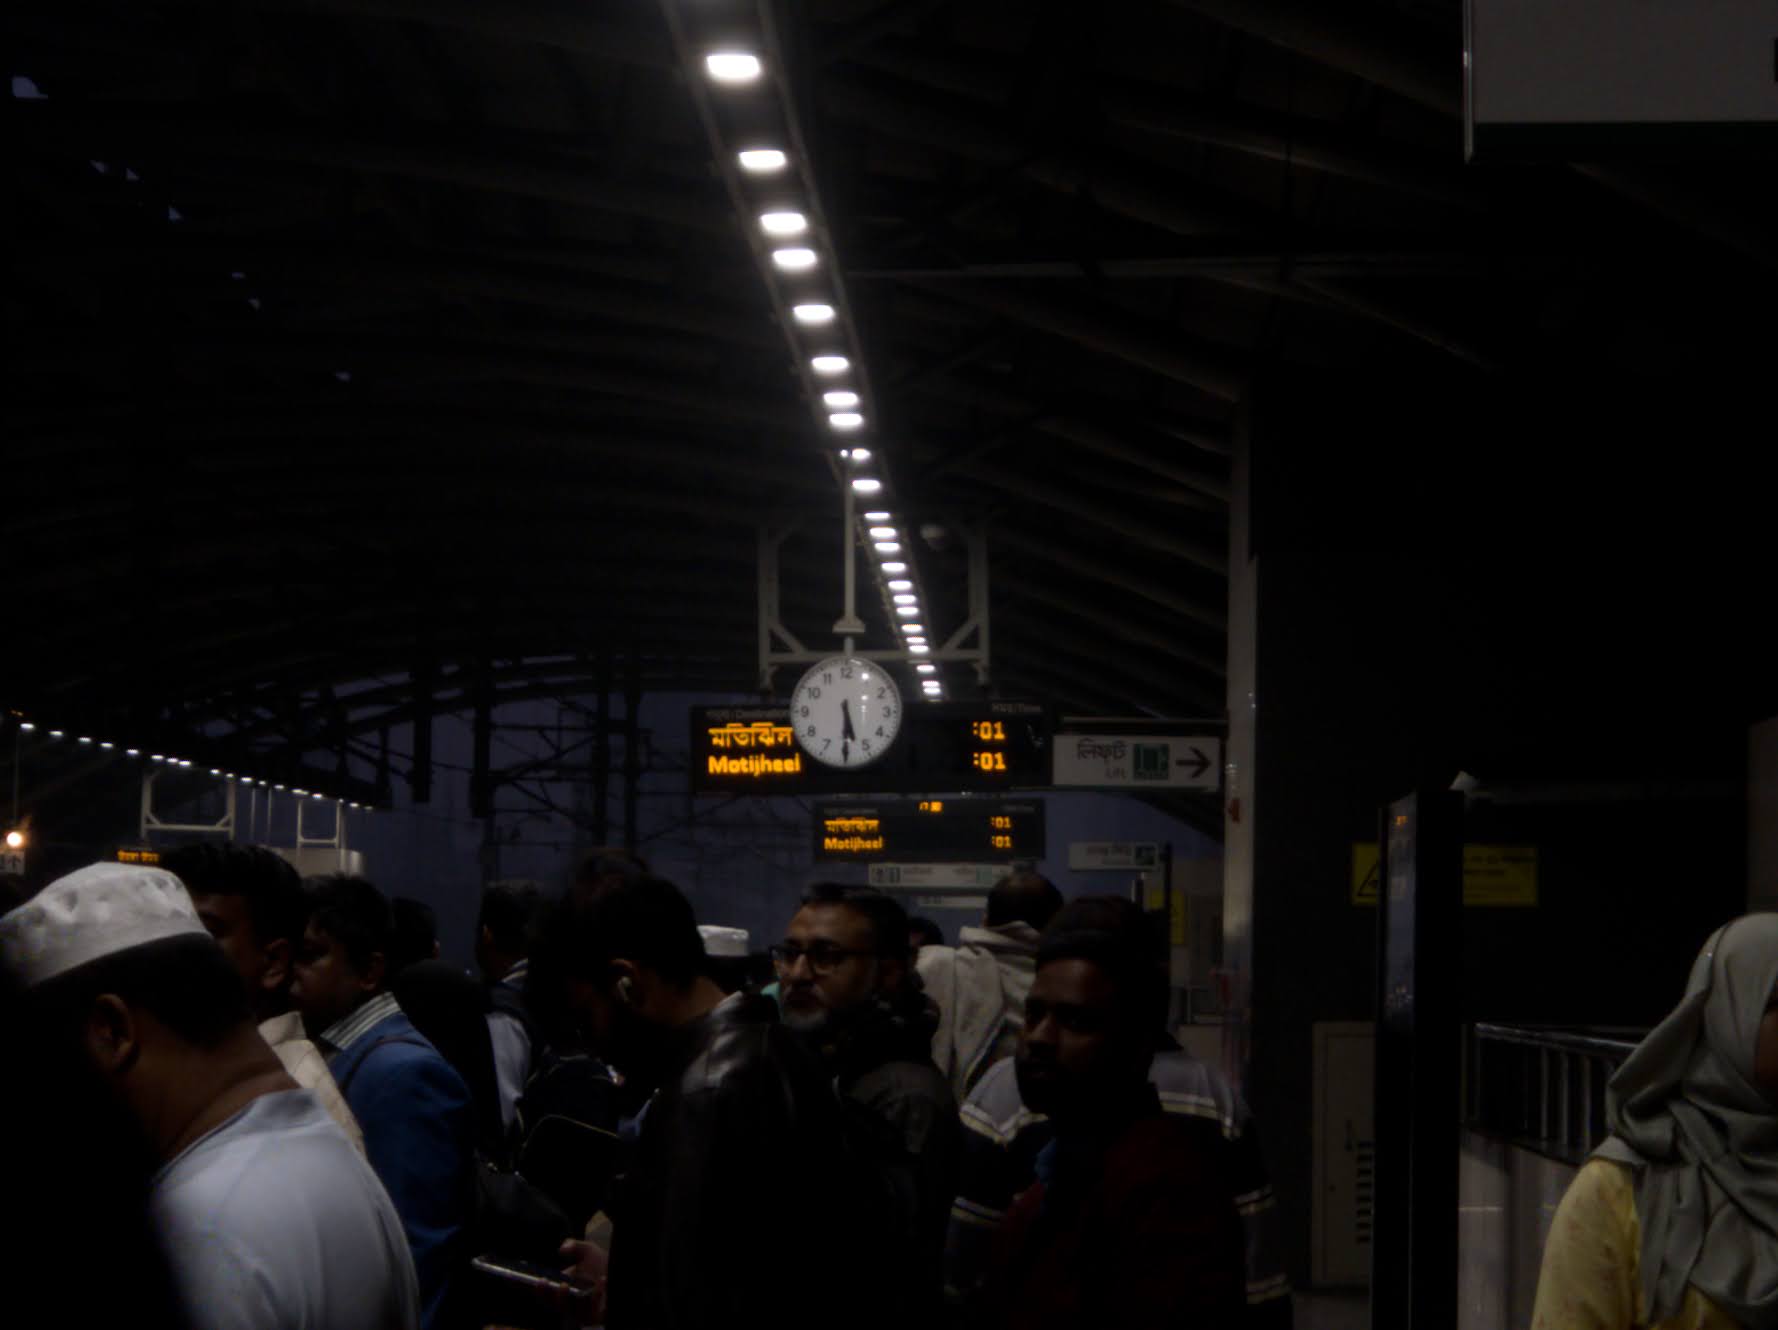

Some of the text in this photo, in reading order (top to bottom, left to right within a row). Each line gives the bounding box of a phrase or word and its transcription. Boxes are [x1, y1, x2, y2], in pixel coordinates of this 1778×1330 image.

[823, 673, 832, 685] 11
[840, 667, 853, 679] 12
[808, 687, 821, 699] 10
[877, 687, 886, 699] 2
[801, 706, 809, 718] 9
[882, 706, 891, 718] 3
[807, 725, 816, 737] 8
[875, 726, 884, 737] 4
[823, 738, 832, 750] 7
[861, 739, 870, 751] 5
[708, 752, 801, 777] Motijheel
